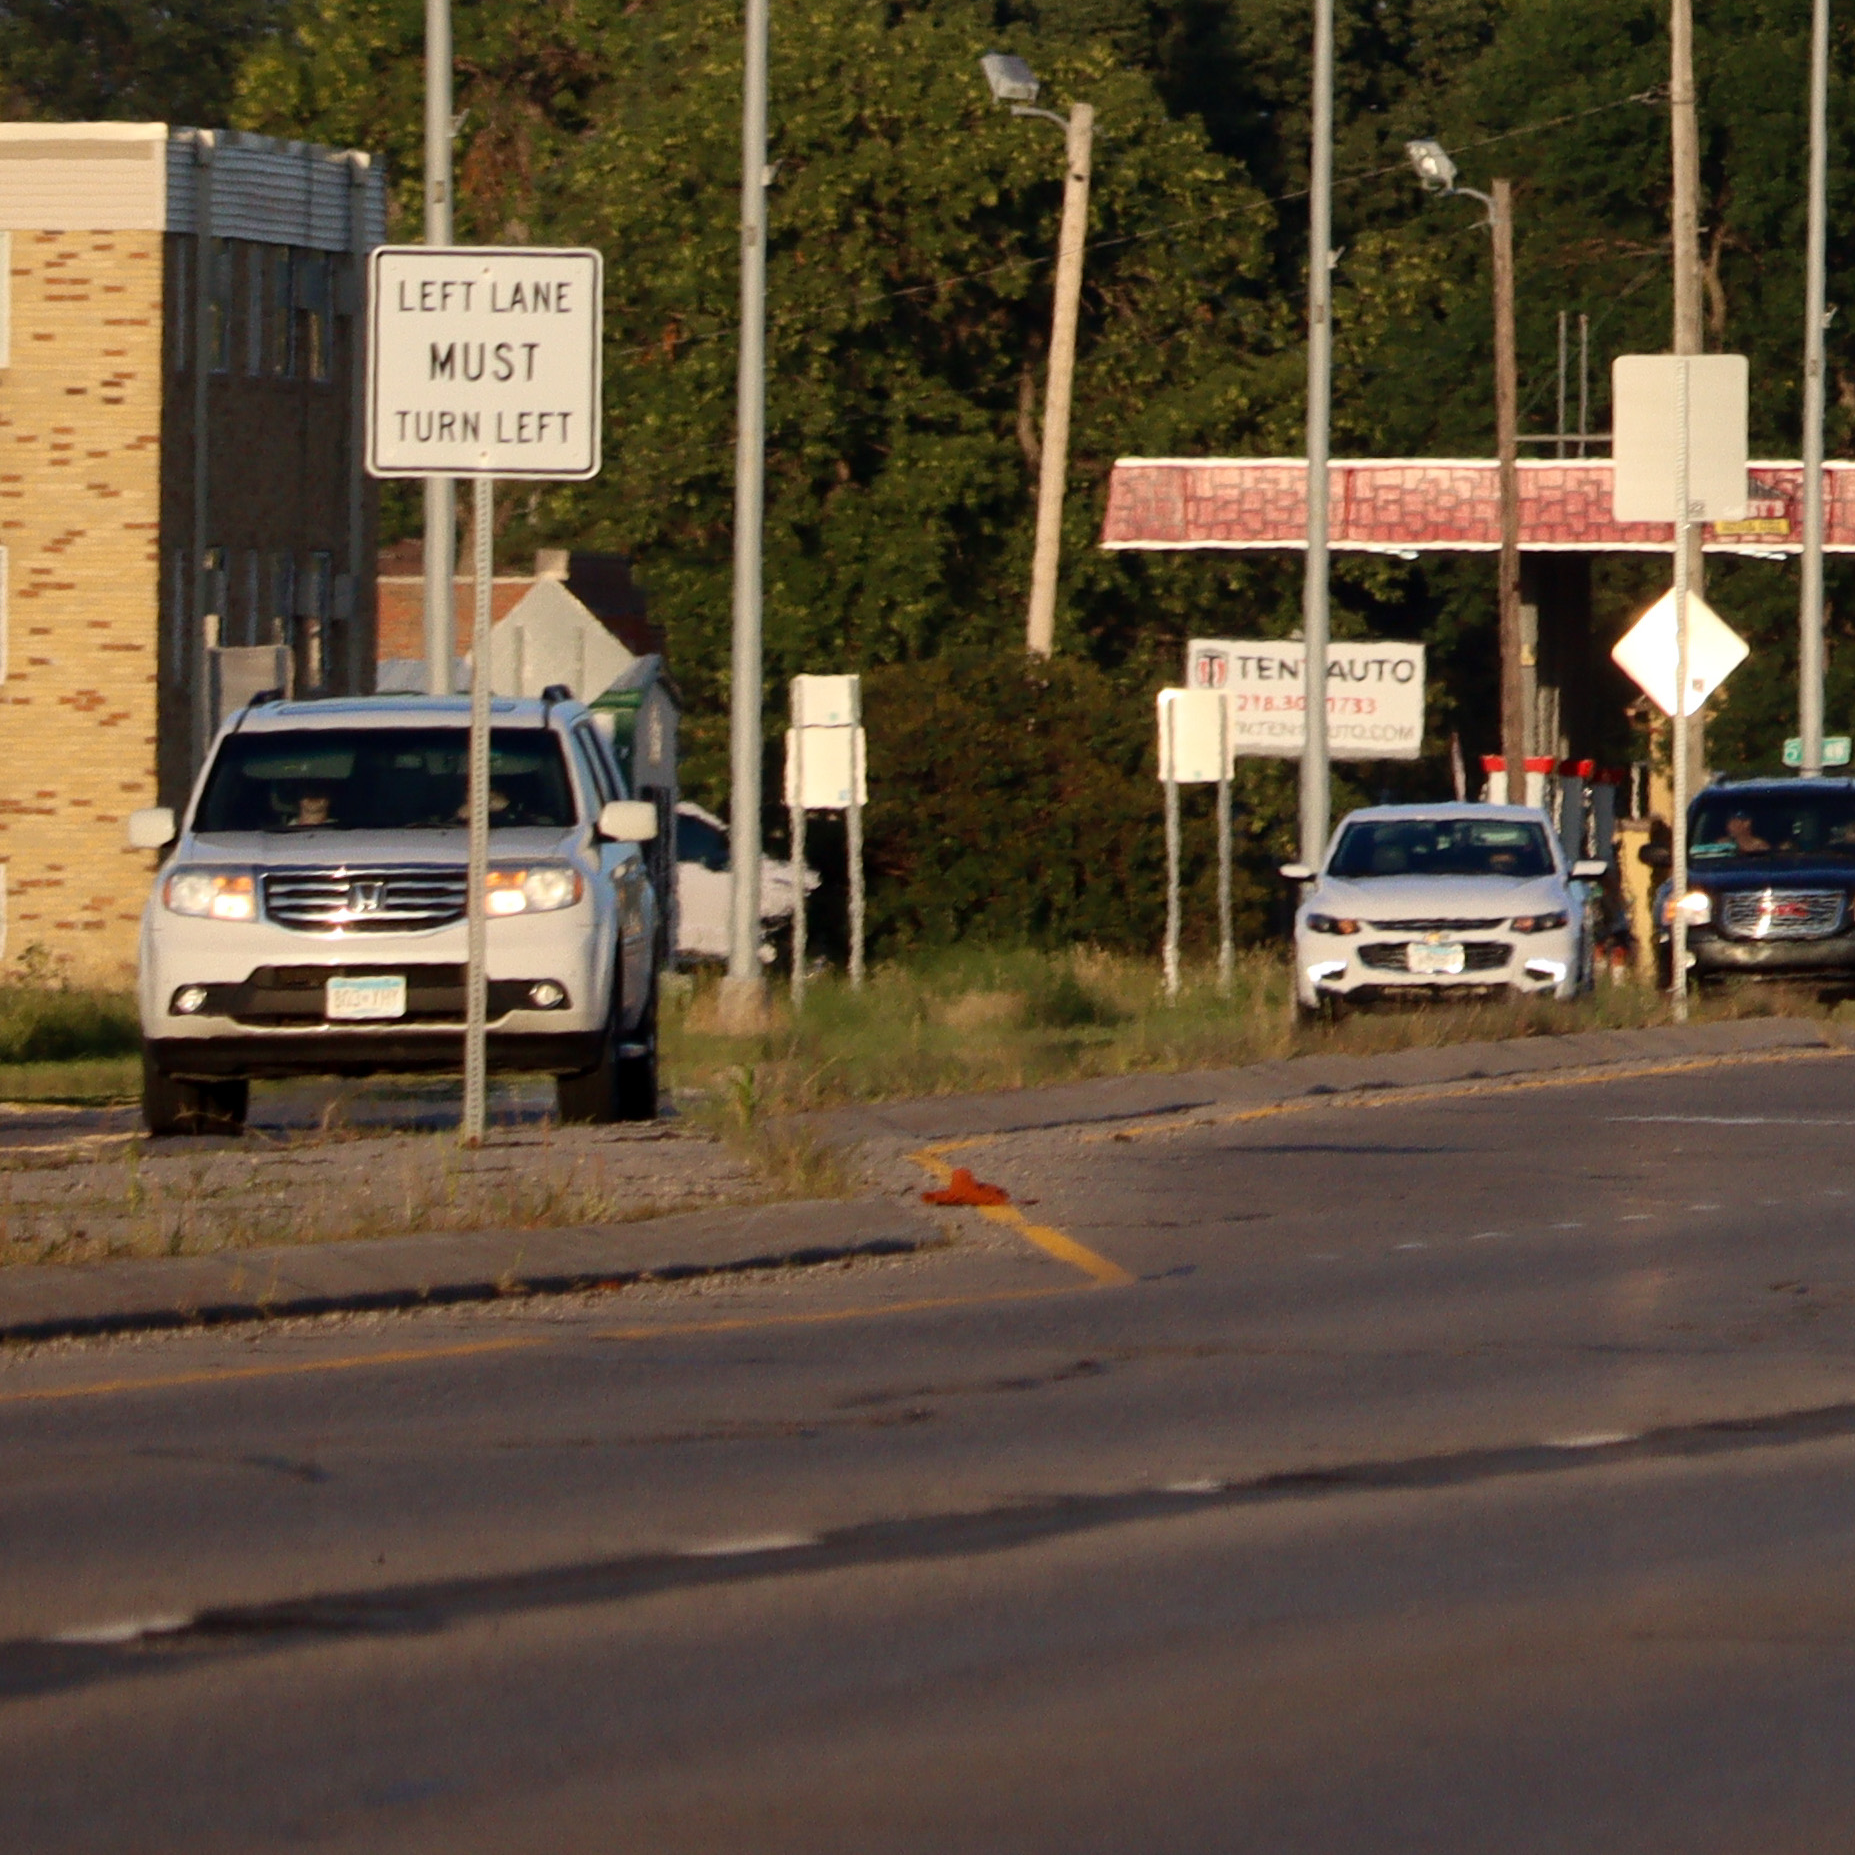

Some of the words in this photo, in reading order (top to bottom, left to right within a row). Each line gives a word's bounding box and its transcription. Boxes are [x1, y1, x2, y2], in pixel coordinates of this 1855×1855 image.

[399, 280, 476, 312] LEFT
[492, 281, 573, 314] LANE
[429, 342, 540, 382] MUST
[396, 411, 480, 442] TURN
[496, 411, 573, 444] LEFT
[1236, 656, 1306, 681] TEN
[1326, 658, 1416, 684] AUTO
